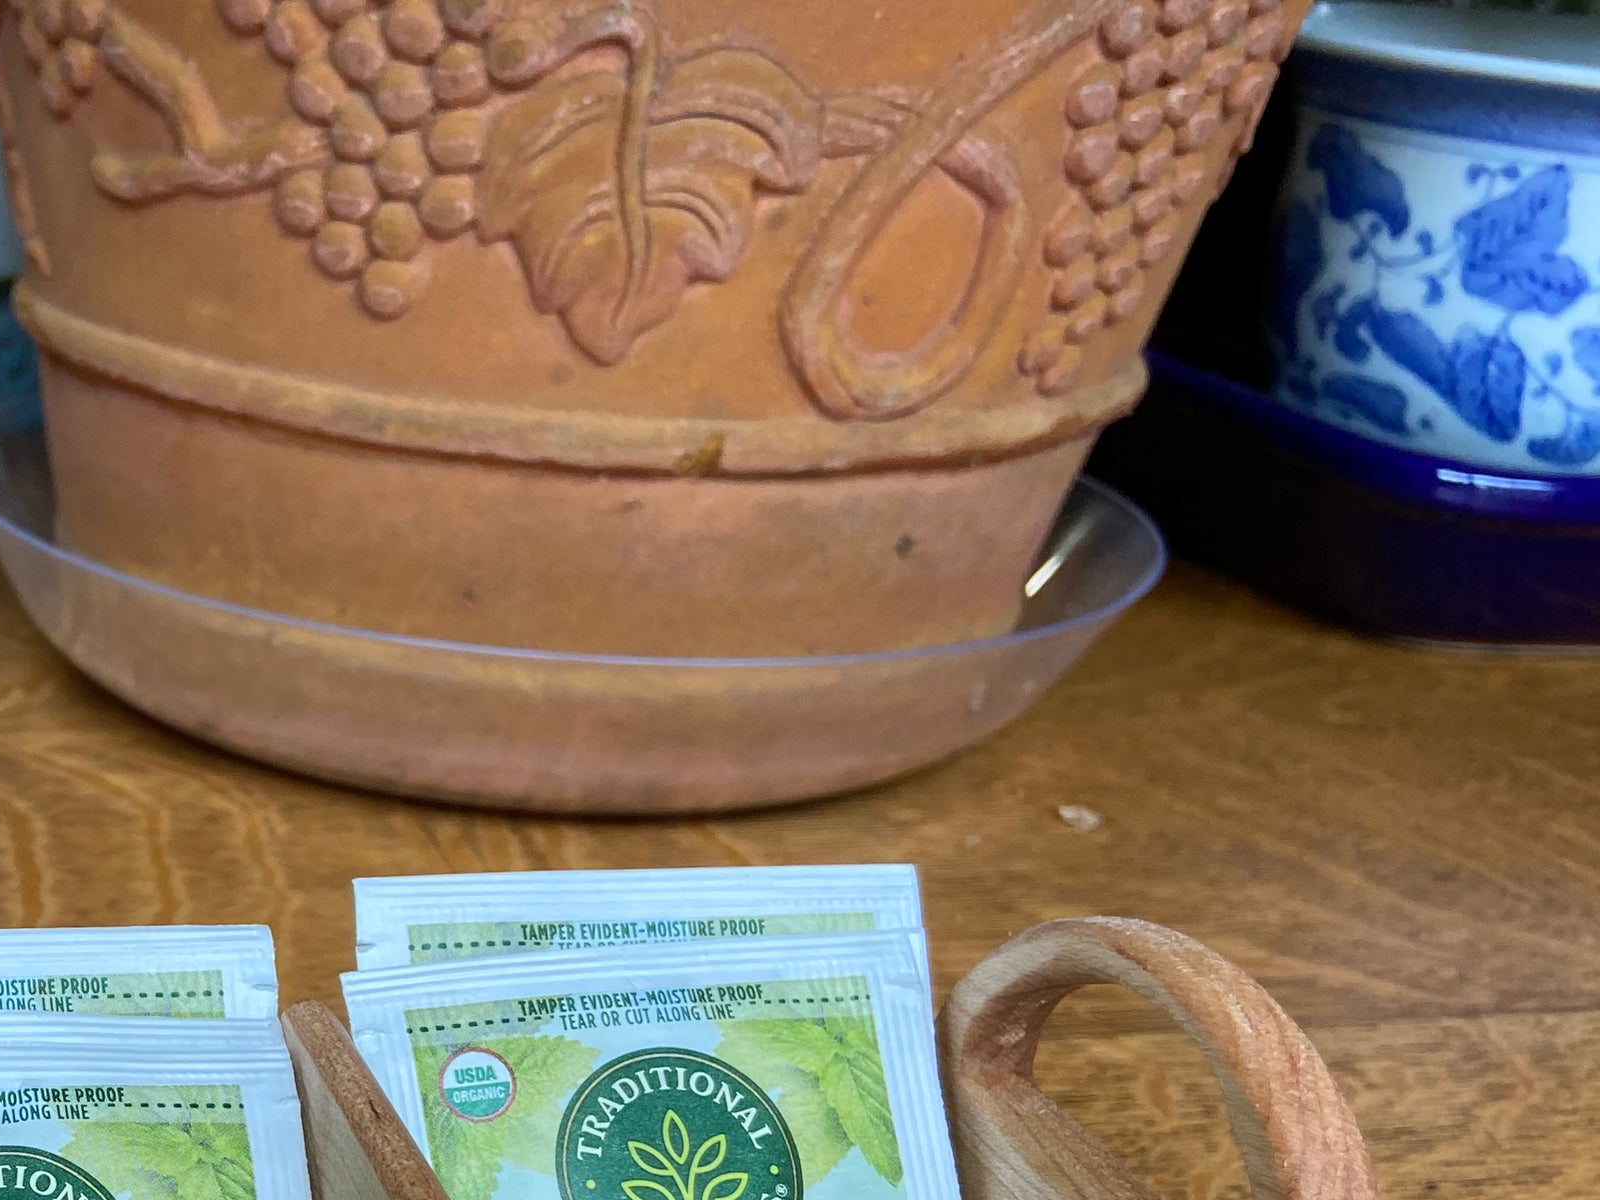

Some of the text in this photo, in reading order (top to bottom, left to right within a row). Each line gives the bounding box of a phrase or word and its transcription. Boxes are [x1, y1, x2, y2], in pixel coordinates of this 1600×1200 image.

[521, 919, 766, 941] TAMPER EVIDENT-MOISTURE PROOF
[61, 976, 108, 995] PROOF
[42, 996, 74, 1012] LINE
[518, 984, 763, 1016] TAMPER EVIDENT-MOISTURE PROOF
[560, 1003, 735, 1031] TEAR OR CUT ALONG LINE
[454, 1065, 497, 1084] USDA
[75, 1087, 125, 1102] PROOF
[452, 1085, 505, 1103] ORGANIC
[1, 1104, 51, 1124] ALONG
[56, 1104, 89, 1120] LINE
[577, 1066, 773, 1161] TRADITIONAL
